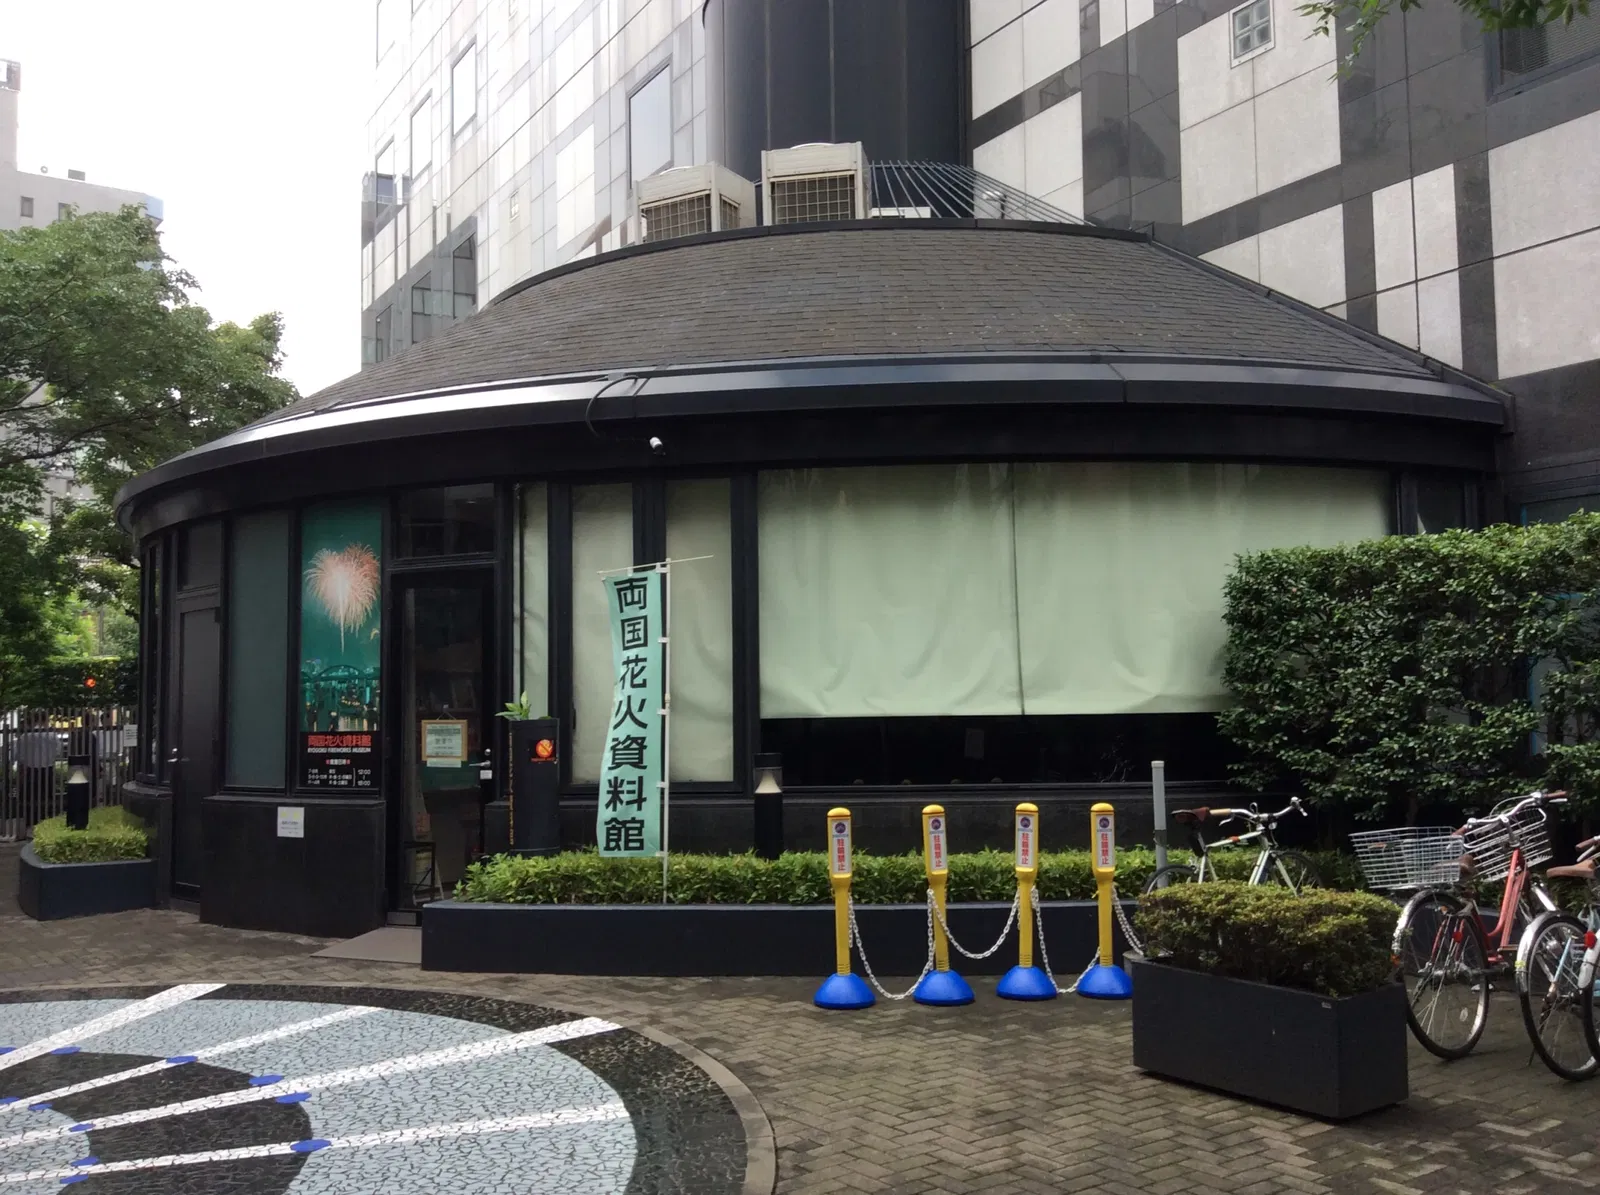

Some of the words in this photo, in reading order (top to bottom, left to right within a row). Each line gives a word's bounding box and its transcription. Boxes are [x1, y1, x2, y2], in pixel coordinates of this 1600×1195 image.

[603, 576, 649, 852] 両国花火資料館
